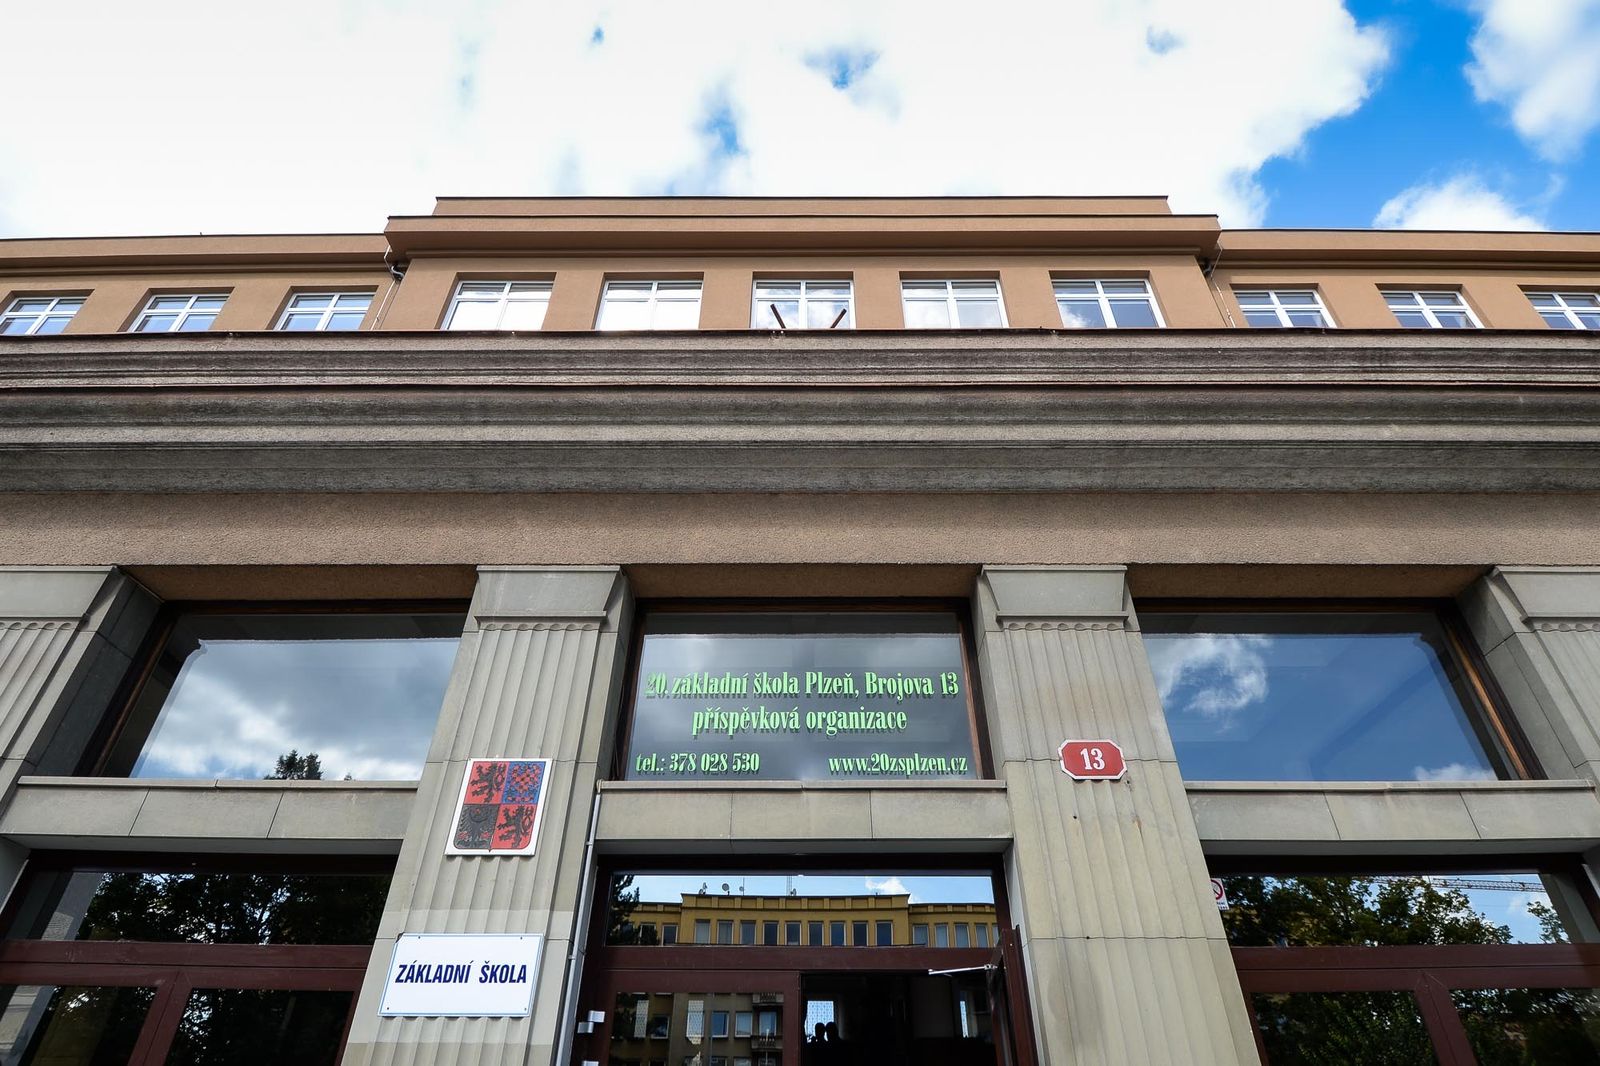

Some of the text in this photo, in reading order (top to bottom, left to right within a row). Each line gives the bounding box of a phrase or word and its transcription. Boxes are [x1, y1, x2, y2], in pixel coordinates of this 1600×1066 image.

[645, 671, 959, 701] 20. základní škola Plzeň, Brojova 13
[692, 705, 908, 736] příspěvková organizace
[635, 752, 760, 772] tel.: 378 028 530
[828, 752, 968, 776] www.20zsplzen.cz
[1080, 748, 1106, 770] 13
[395, 960, 528, 984] ZÁKLADNÍ ŠKOLA
